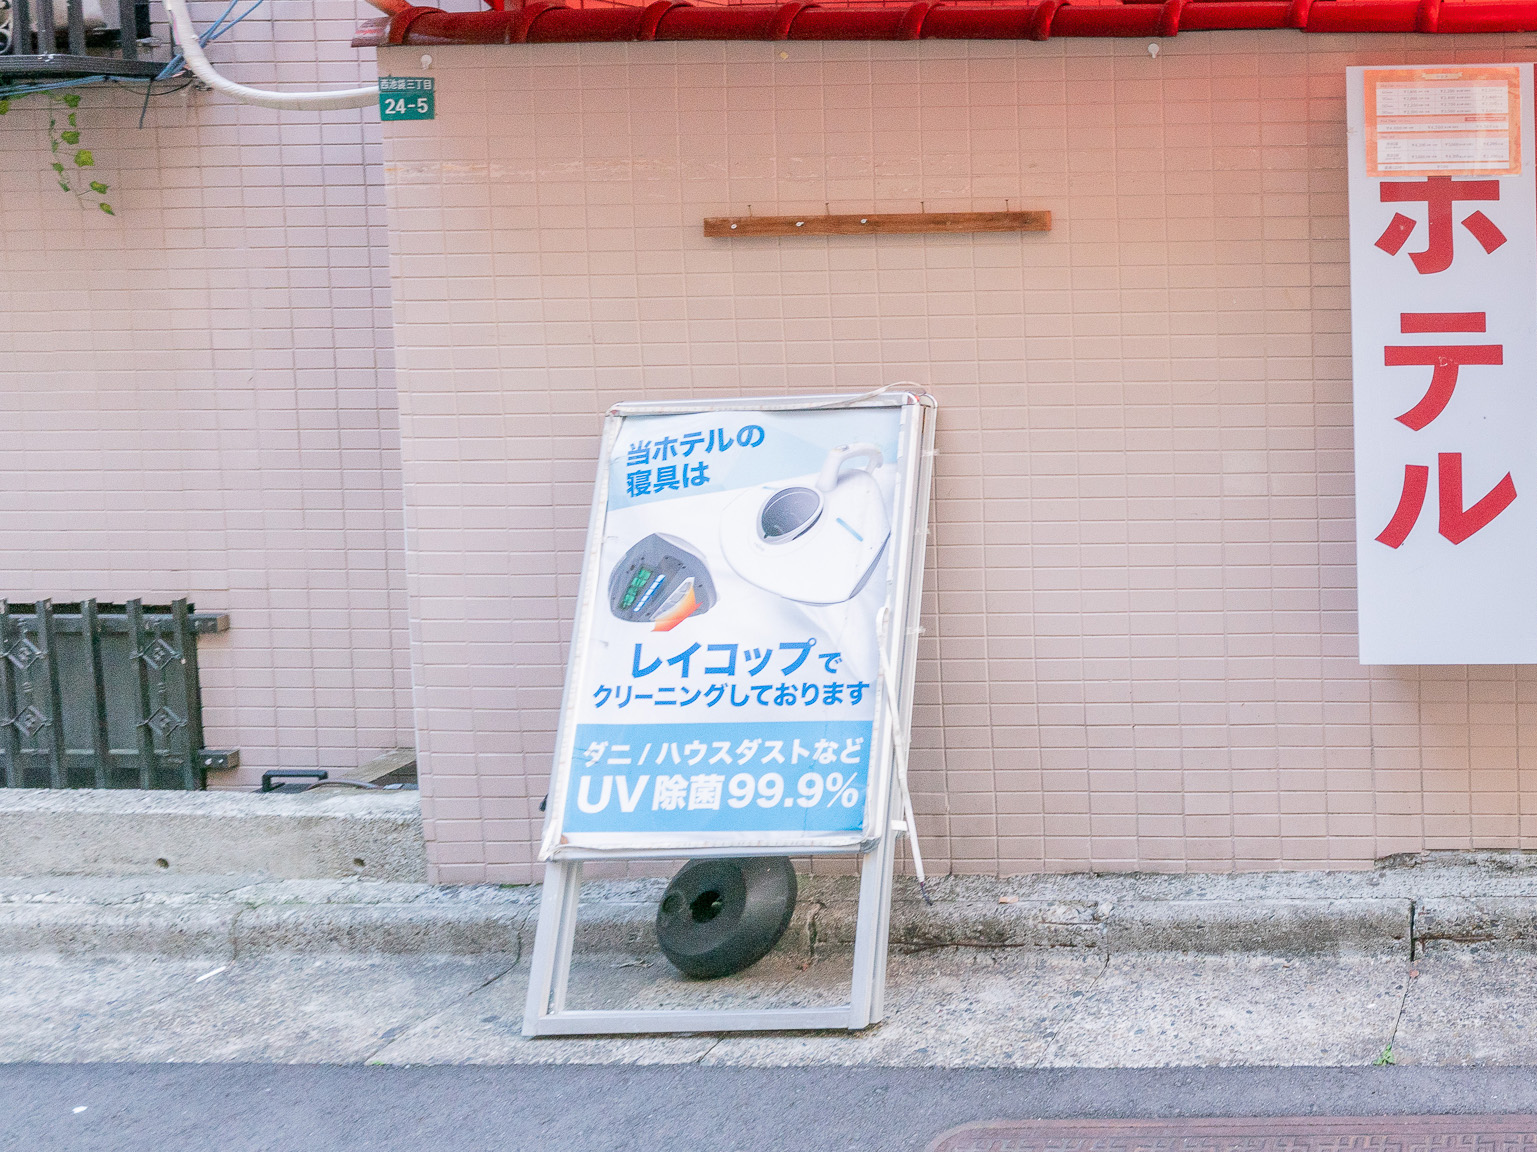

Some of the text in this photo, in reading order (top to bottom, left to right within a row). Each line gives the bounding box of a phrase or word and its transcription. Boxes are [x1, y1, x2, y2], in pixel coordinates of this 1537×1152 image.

[384, 98, 429, 114] 24-5
[1374, 175, 1518, 549] ホテル
[626, 424, 765, 467] 当ホテルの
[626, 461, 710, 499] 寝具は
[631, 637, 842, 679] レイコップで
[593, 681, 870, 710] クリーニングしております
